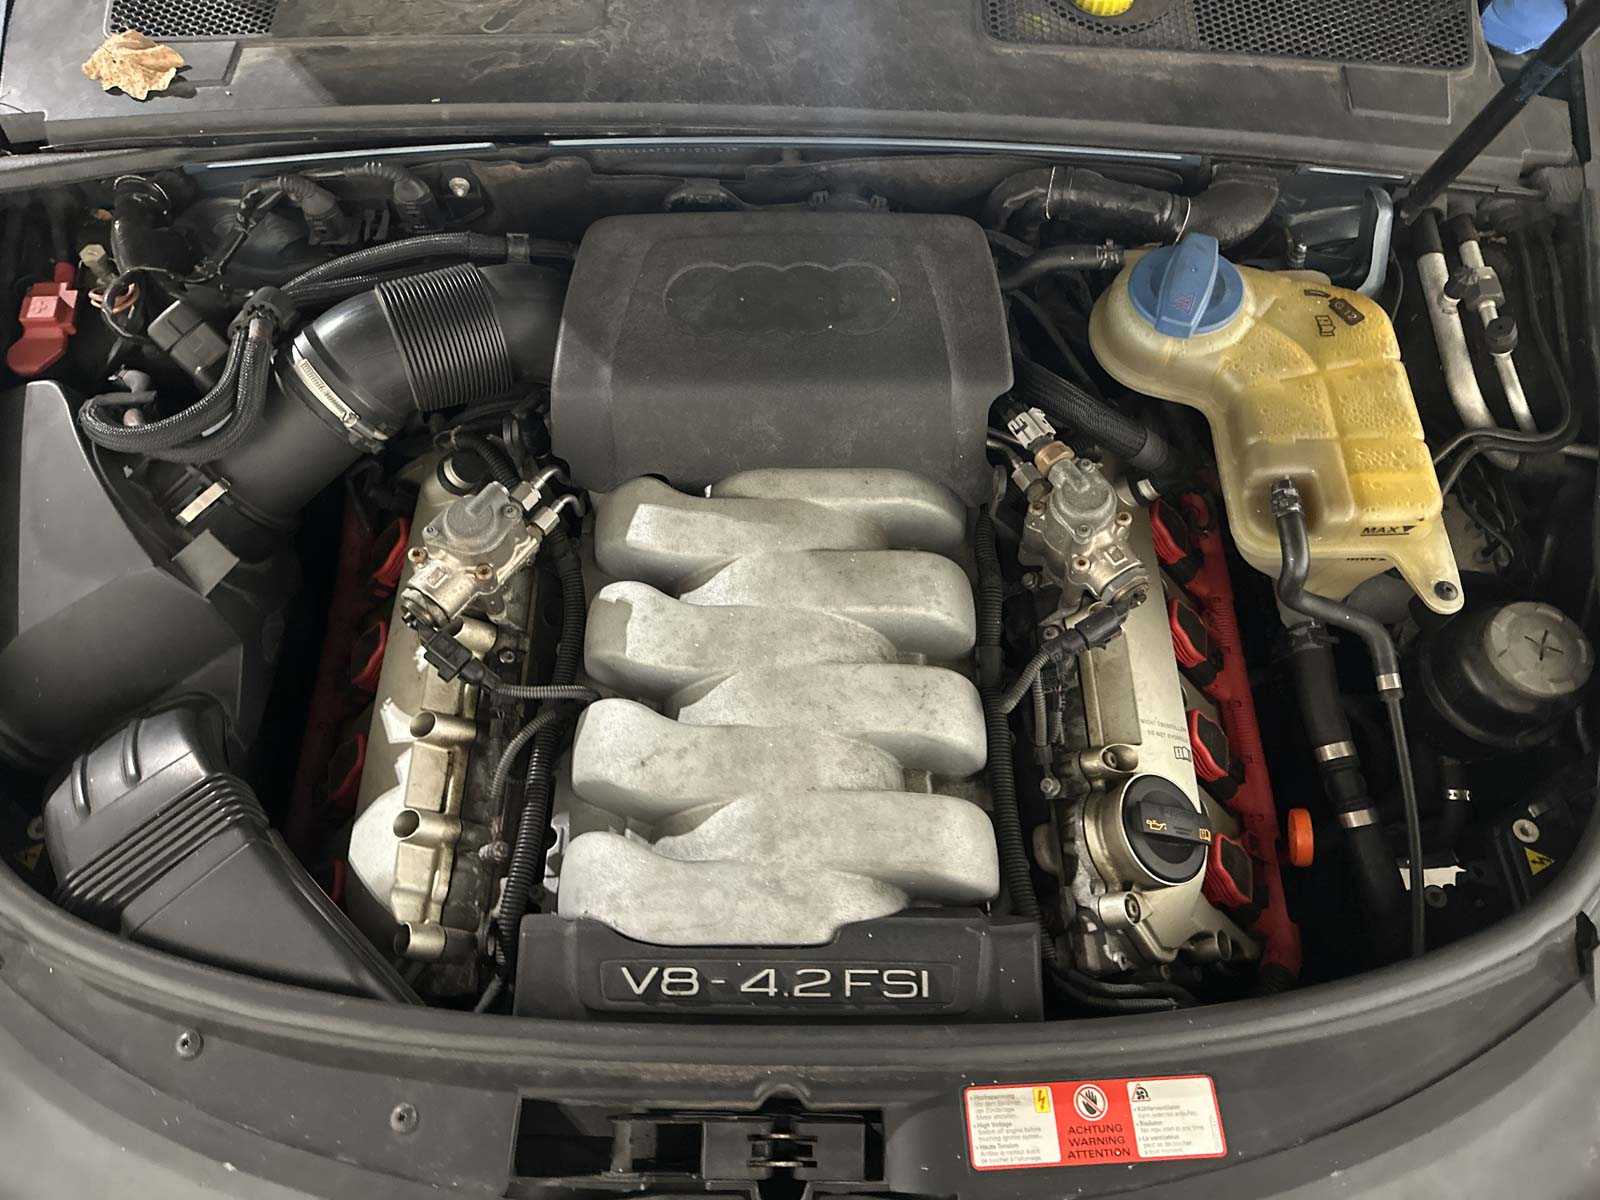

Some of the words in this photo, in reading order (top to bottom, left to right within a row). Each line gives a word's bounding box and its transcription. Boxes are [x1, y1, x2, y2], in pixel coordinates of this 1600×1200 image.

[1362, 525, 1399, 534] MAX
[621, 967, 699, 996] V8
[740, 968, 832, 998] 4.2
[845, 969, 928, 998] FSI
[1068, 1123, 1123, 1135] ACHTUNG
[1068, 1135, 1126, 1147] WARNING
[1067, 1147, 1131, 1159] ATTENTION
